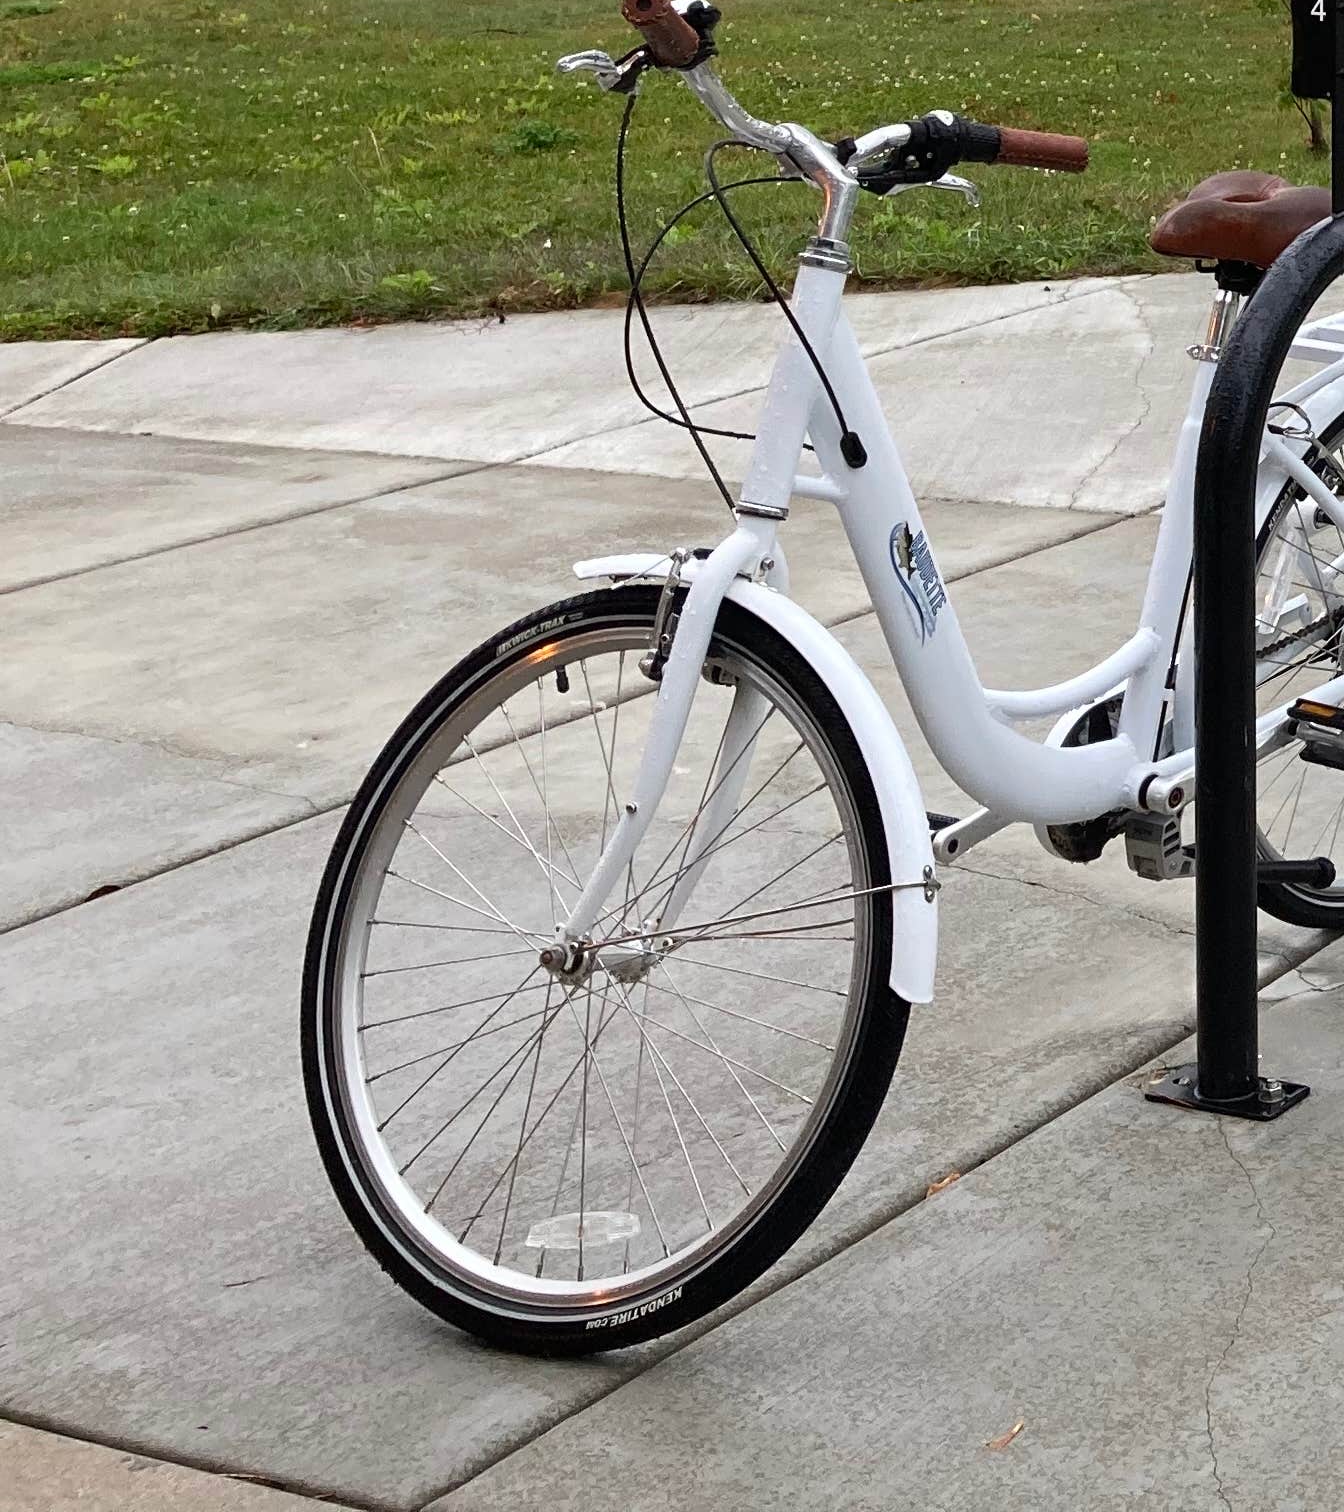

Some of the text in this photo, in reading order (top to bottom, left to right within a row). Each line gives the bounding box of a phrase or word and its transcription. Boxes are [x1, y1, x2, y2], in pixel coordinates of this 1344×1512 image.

[910, 529, 948, 617] BAUDETTE
[505, 614, 567, 650] KWICK-TRAX
[585, 1285, 683, 1330] KENDATIRE.COM
